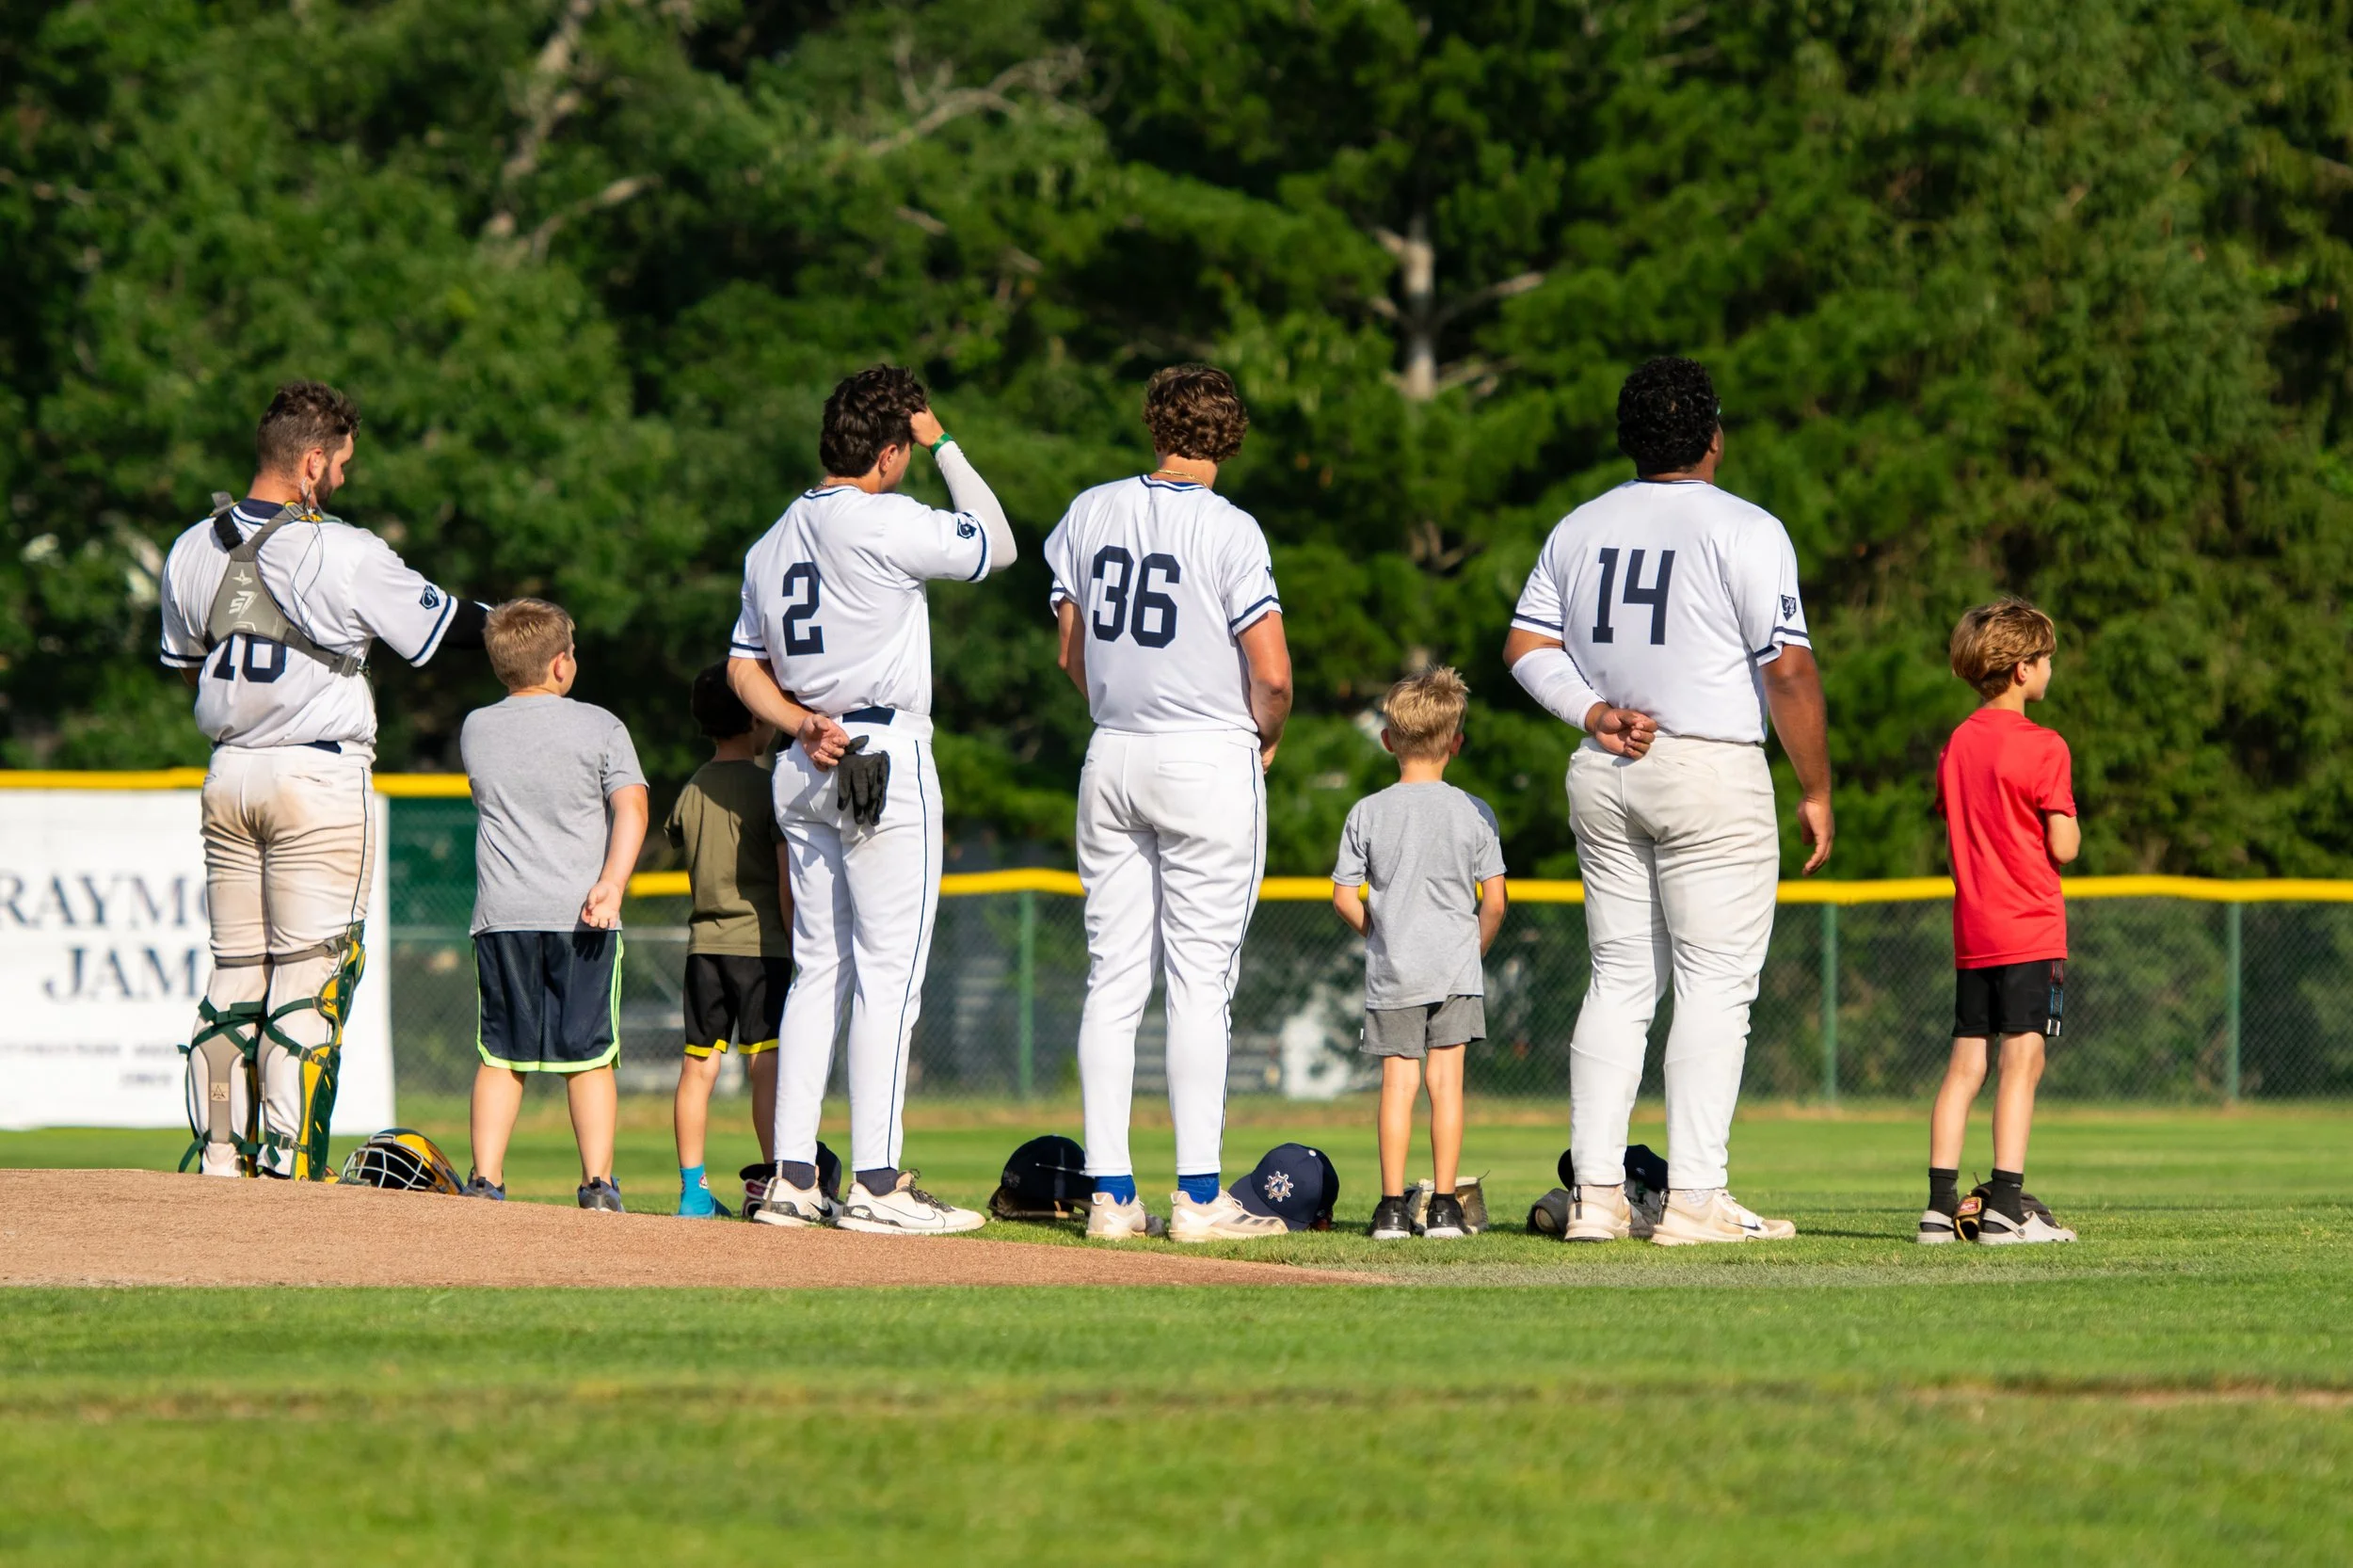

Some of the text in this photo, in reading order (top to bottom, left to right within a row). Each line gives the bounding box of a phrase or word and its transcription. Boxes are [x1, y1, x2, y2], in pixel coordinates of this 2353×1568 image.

[782, 562, 824, 656] 2
[1093, 545, 1181, 648] 36
[1593, 548, 1675, 646] 14
[0, 872, 209, 928] RAYM
